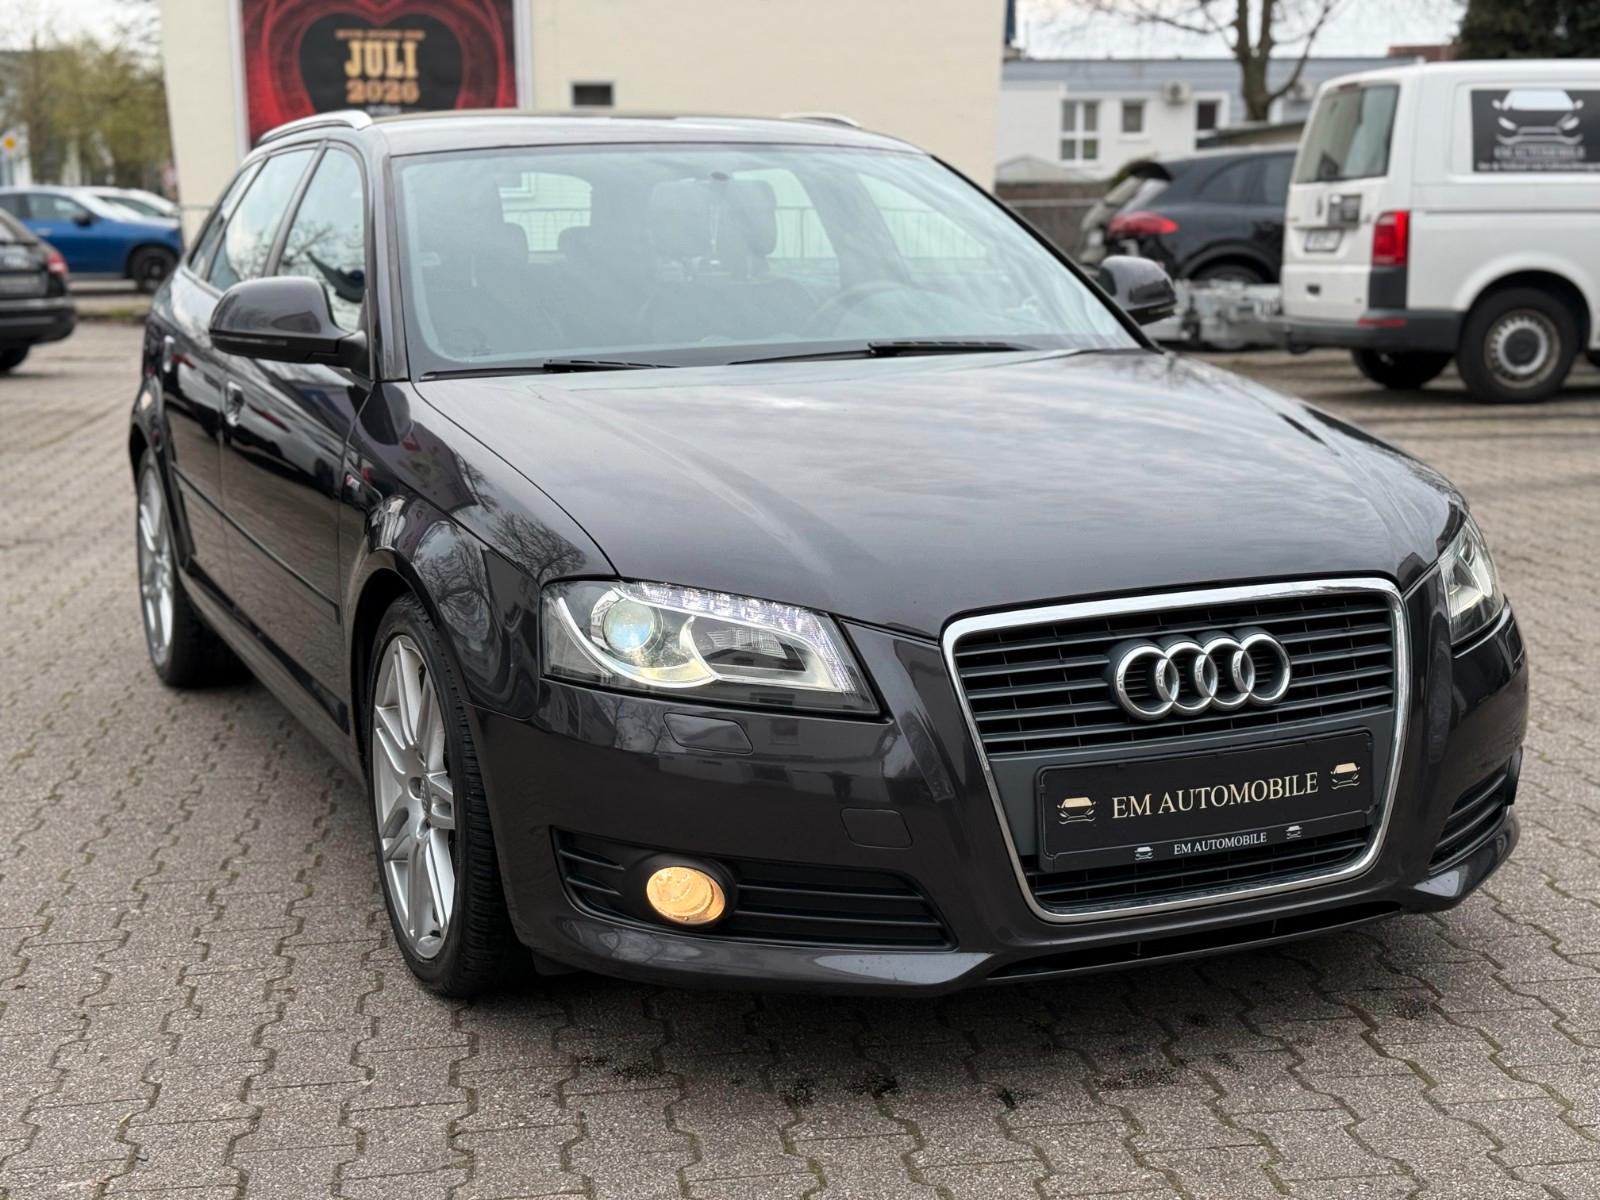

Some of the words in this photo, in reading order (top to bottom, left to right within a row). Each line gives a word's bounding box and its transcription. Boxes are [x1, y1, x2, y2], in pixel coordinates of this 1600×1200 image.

[345, 41, 418, 77] JULI
[1111, 793, 1153, 819] EM
[1157, 771, 1319, 814] AUTOMOBILE
[1173, 843, 1191, 855] EM
[1194, 832, 1268, 853] AUTOMOBILE
